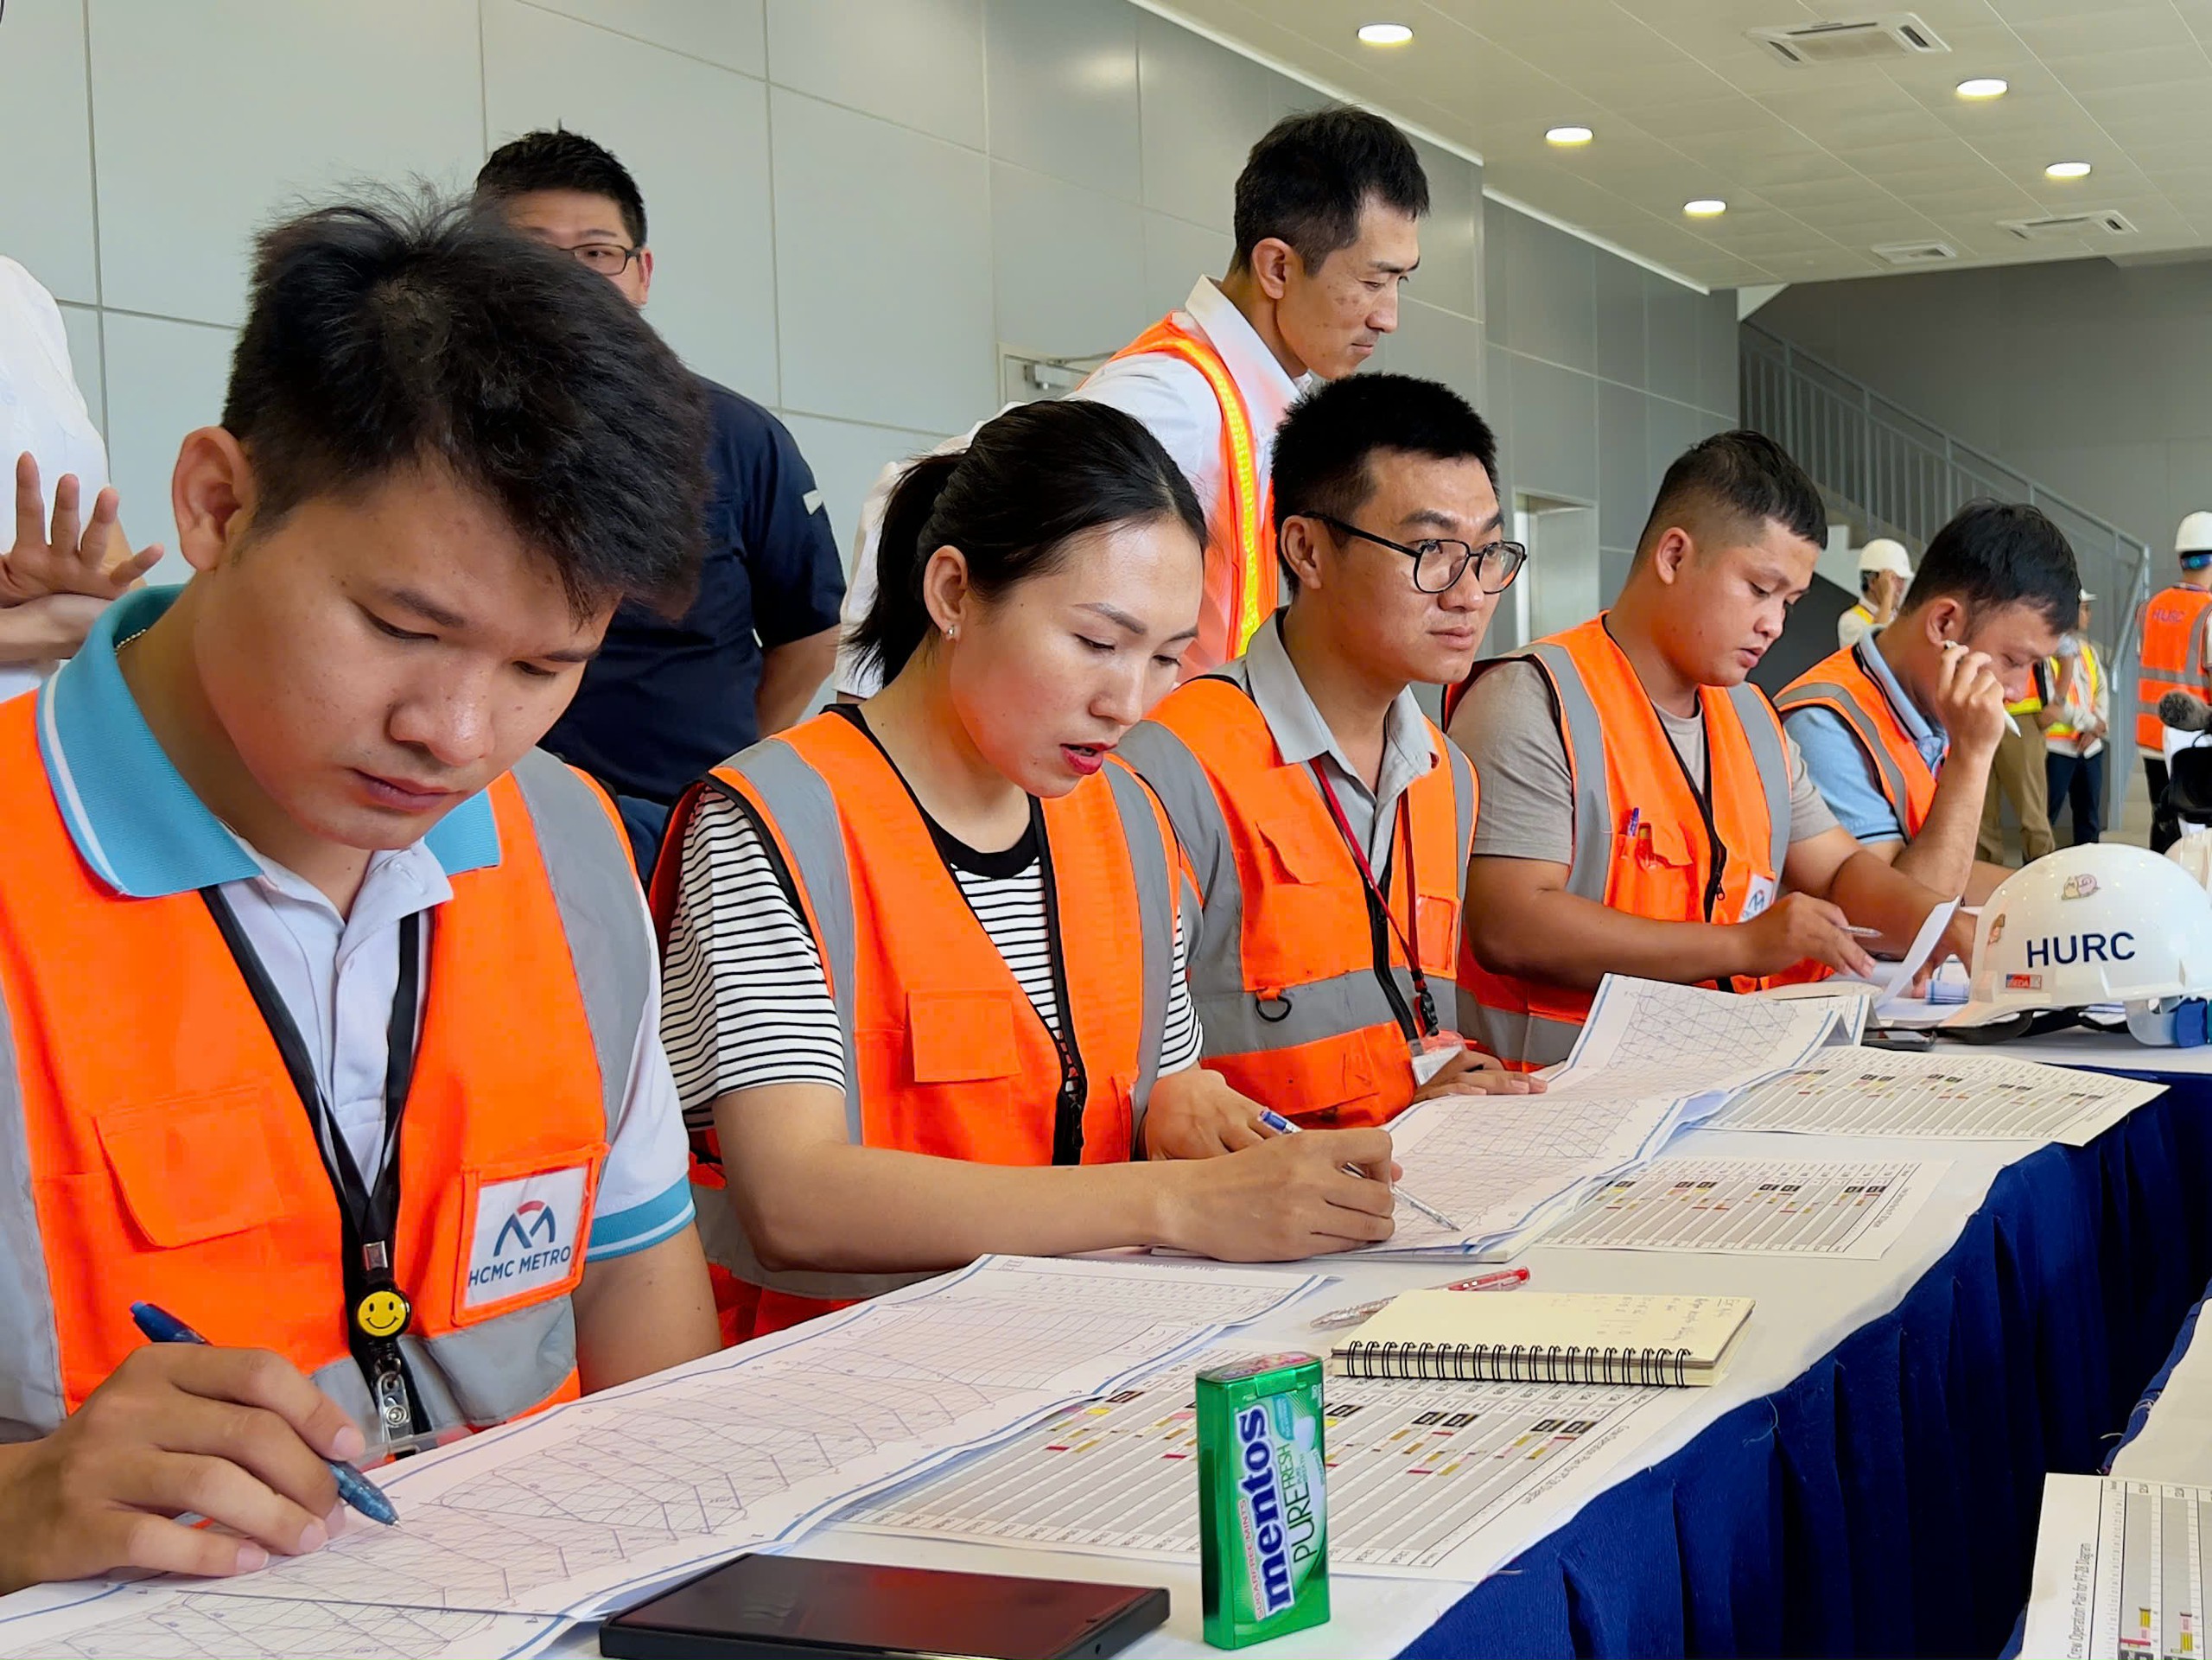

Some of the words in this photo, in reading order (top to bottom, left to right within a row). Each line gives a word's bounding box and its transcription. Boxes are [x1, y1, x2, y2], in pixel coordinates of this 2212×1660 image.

[2026, 931, 2136, 968] HURC
[468, 1259, 514, 1288] HCMC
[518, 1246, 571, 1274] METRO
[1276, 1443, 1298, 1489] FRESH
[1239, 1408, 1293, 1612] mentos
[1240, 1499, 1252, 1540] MINTS
[1283, 1481, 1318, 1563] PURE
[2075, 1542, 2094, 1565] Diagram
[1247, 1543, 1263, 1619] SUGARFREE
[2072, 1581, 2087, 1591] for
[2072, 1592, 2087, 1606] Plan
[2069, 1606, 2087, 1641] Operation
